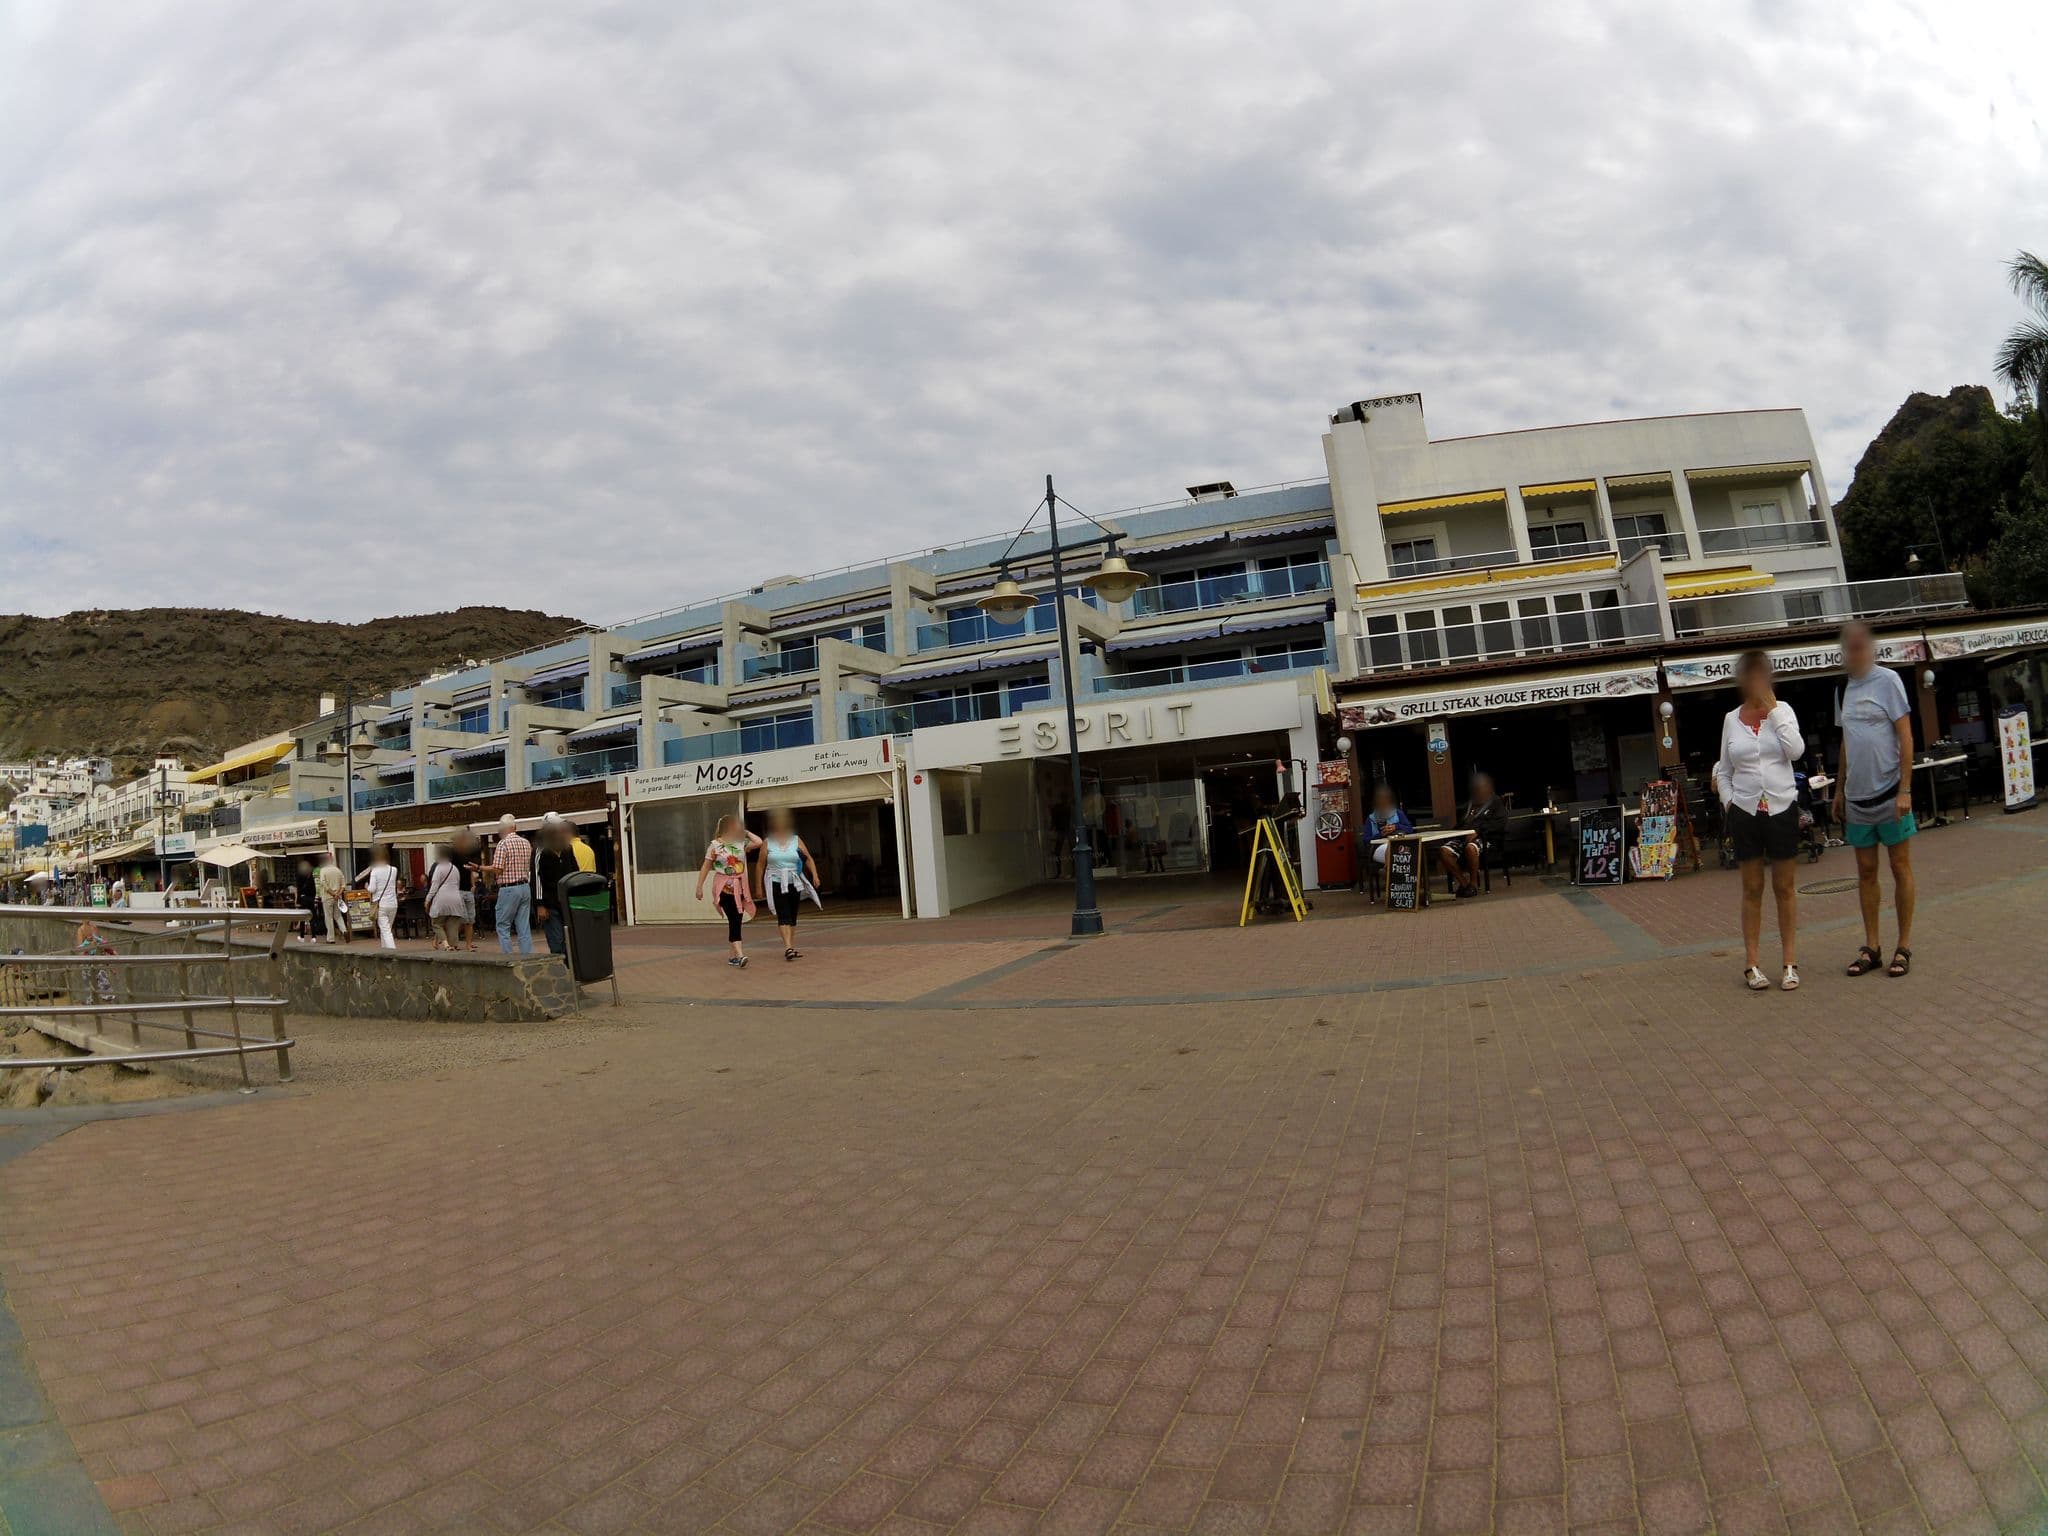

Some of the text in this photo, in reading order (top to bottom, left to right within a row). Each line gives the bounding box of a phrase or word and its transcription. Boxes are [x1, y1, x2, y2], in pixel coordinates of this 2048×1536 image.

[1704, 663, 1731, 677] BAR
[1772, 654, 1821, 670] URANTE
[1400, 681, 1601, 717] GRILL STEAK HOUSE FRESH FISH
[999, 701, 1193, 755] ESPRIT
[814, 753, 829, 761] Eat
[821, 762, 841, 771] Take
[843, 759, 868, 769] Away
[651, 775, 671, 783] tomar
[696, 761, 754, 786] Mogs
[647, 786, 662, 795] para
[664, 783, 682, 791] llevar
[697, 775, 789, 793] Auténtico Bar de Tapas
[1582, 828, 1609, 844] MIX
[1392, 854, 1412, 863] TODAY
[1392, 864, 1411, 873] FRESH
